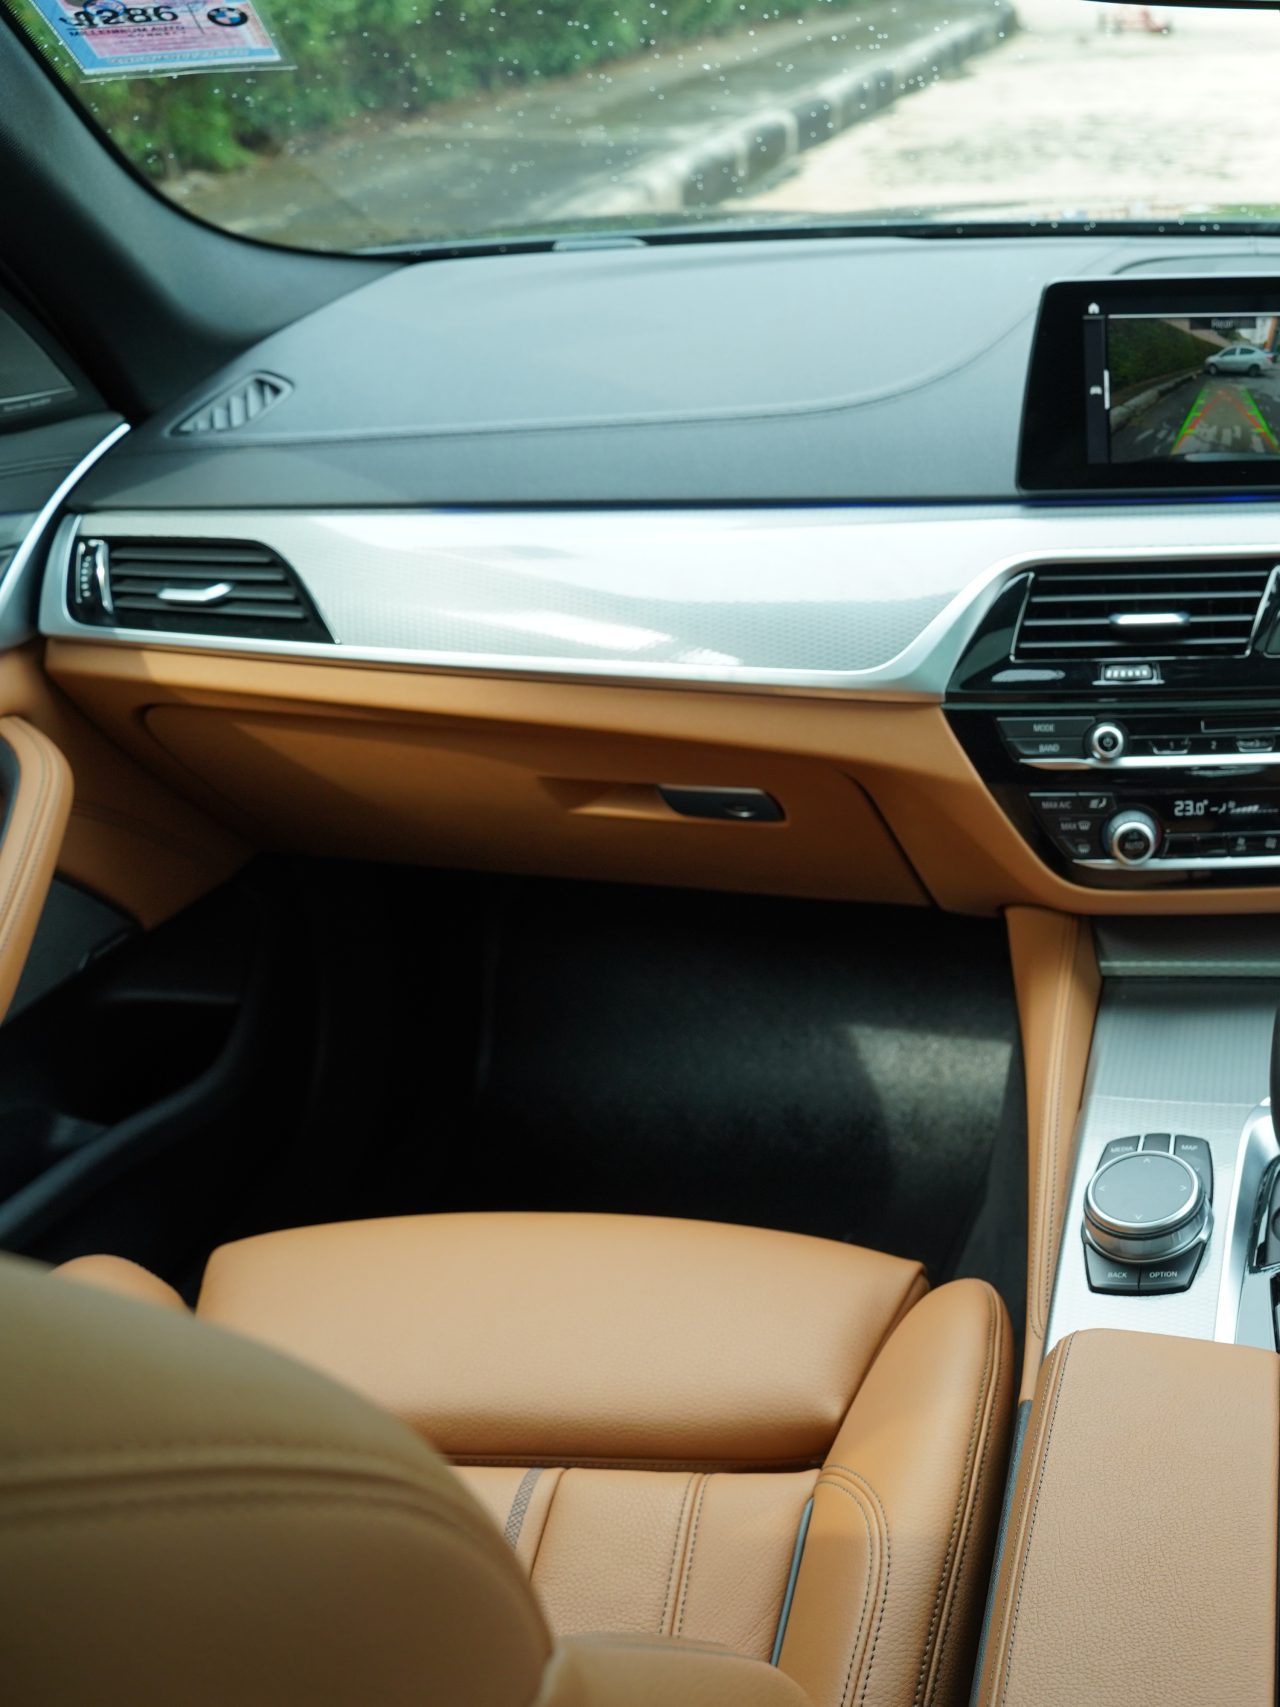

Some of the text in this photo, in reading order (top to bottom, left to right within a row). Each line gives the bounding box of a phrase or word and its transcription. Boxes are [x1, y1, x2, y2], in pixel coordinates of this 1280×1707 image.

[1033, 723, 1055, 732] MODE
[1039, 744, 1060, 753] BAND
[1124, 840, 1145, 850] AUTO
[1110, 1145, 1134, 1153] MEDIA
[1107, 1271, 1128, 1279] BACK
[1149, 1270, 1178, 1279] OPTION
